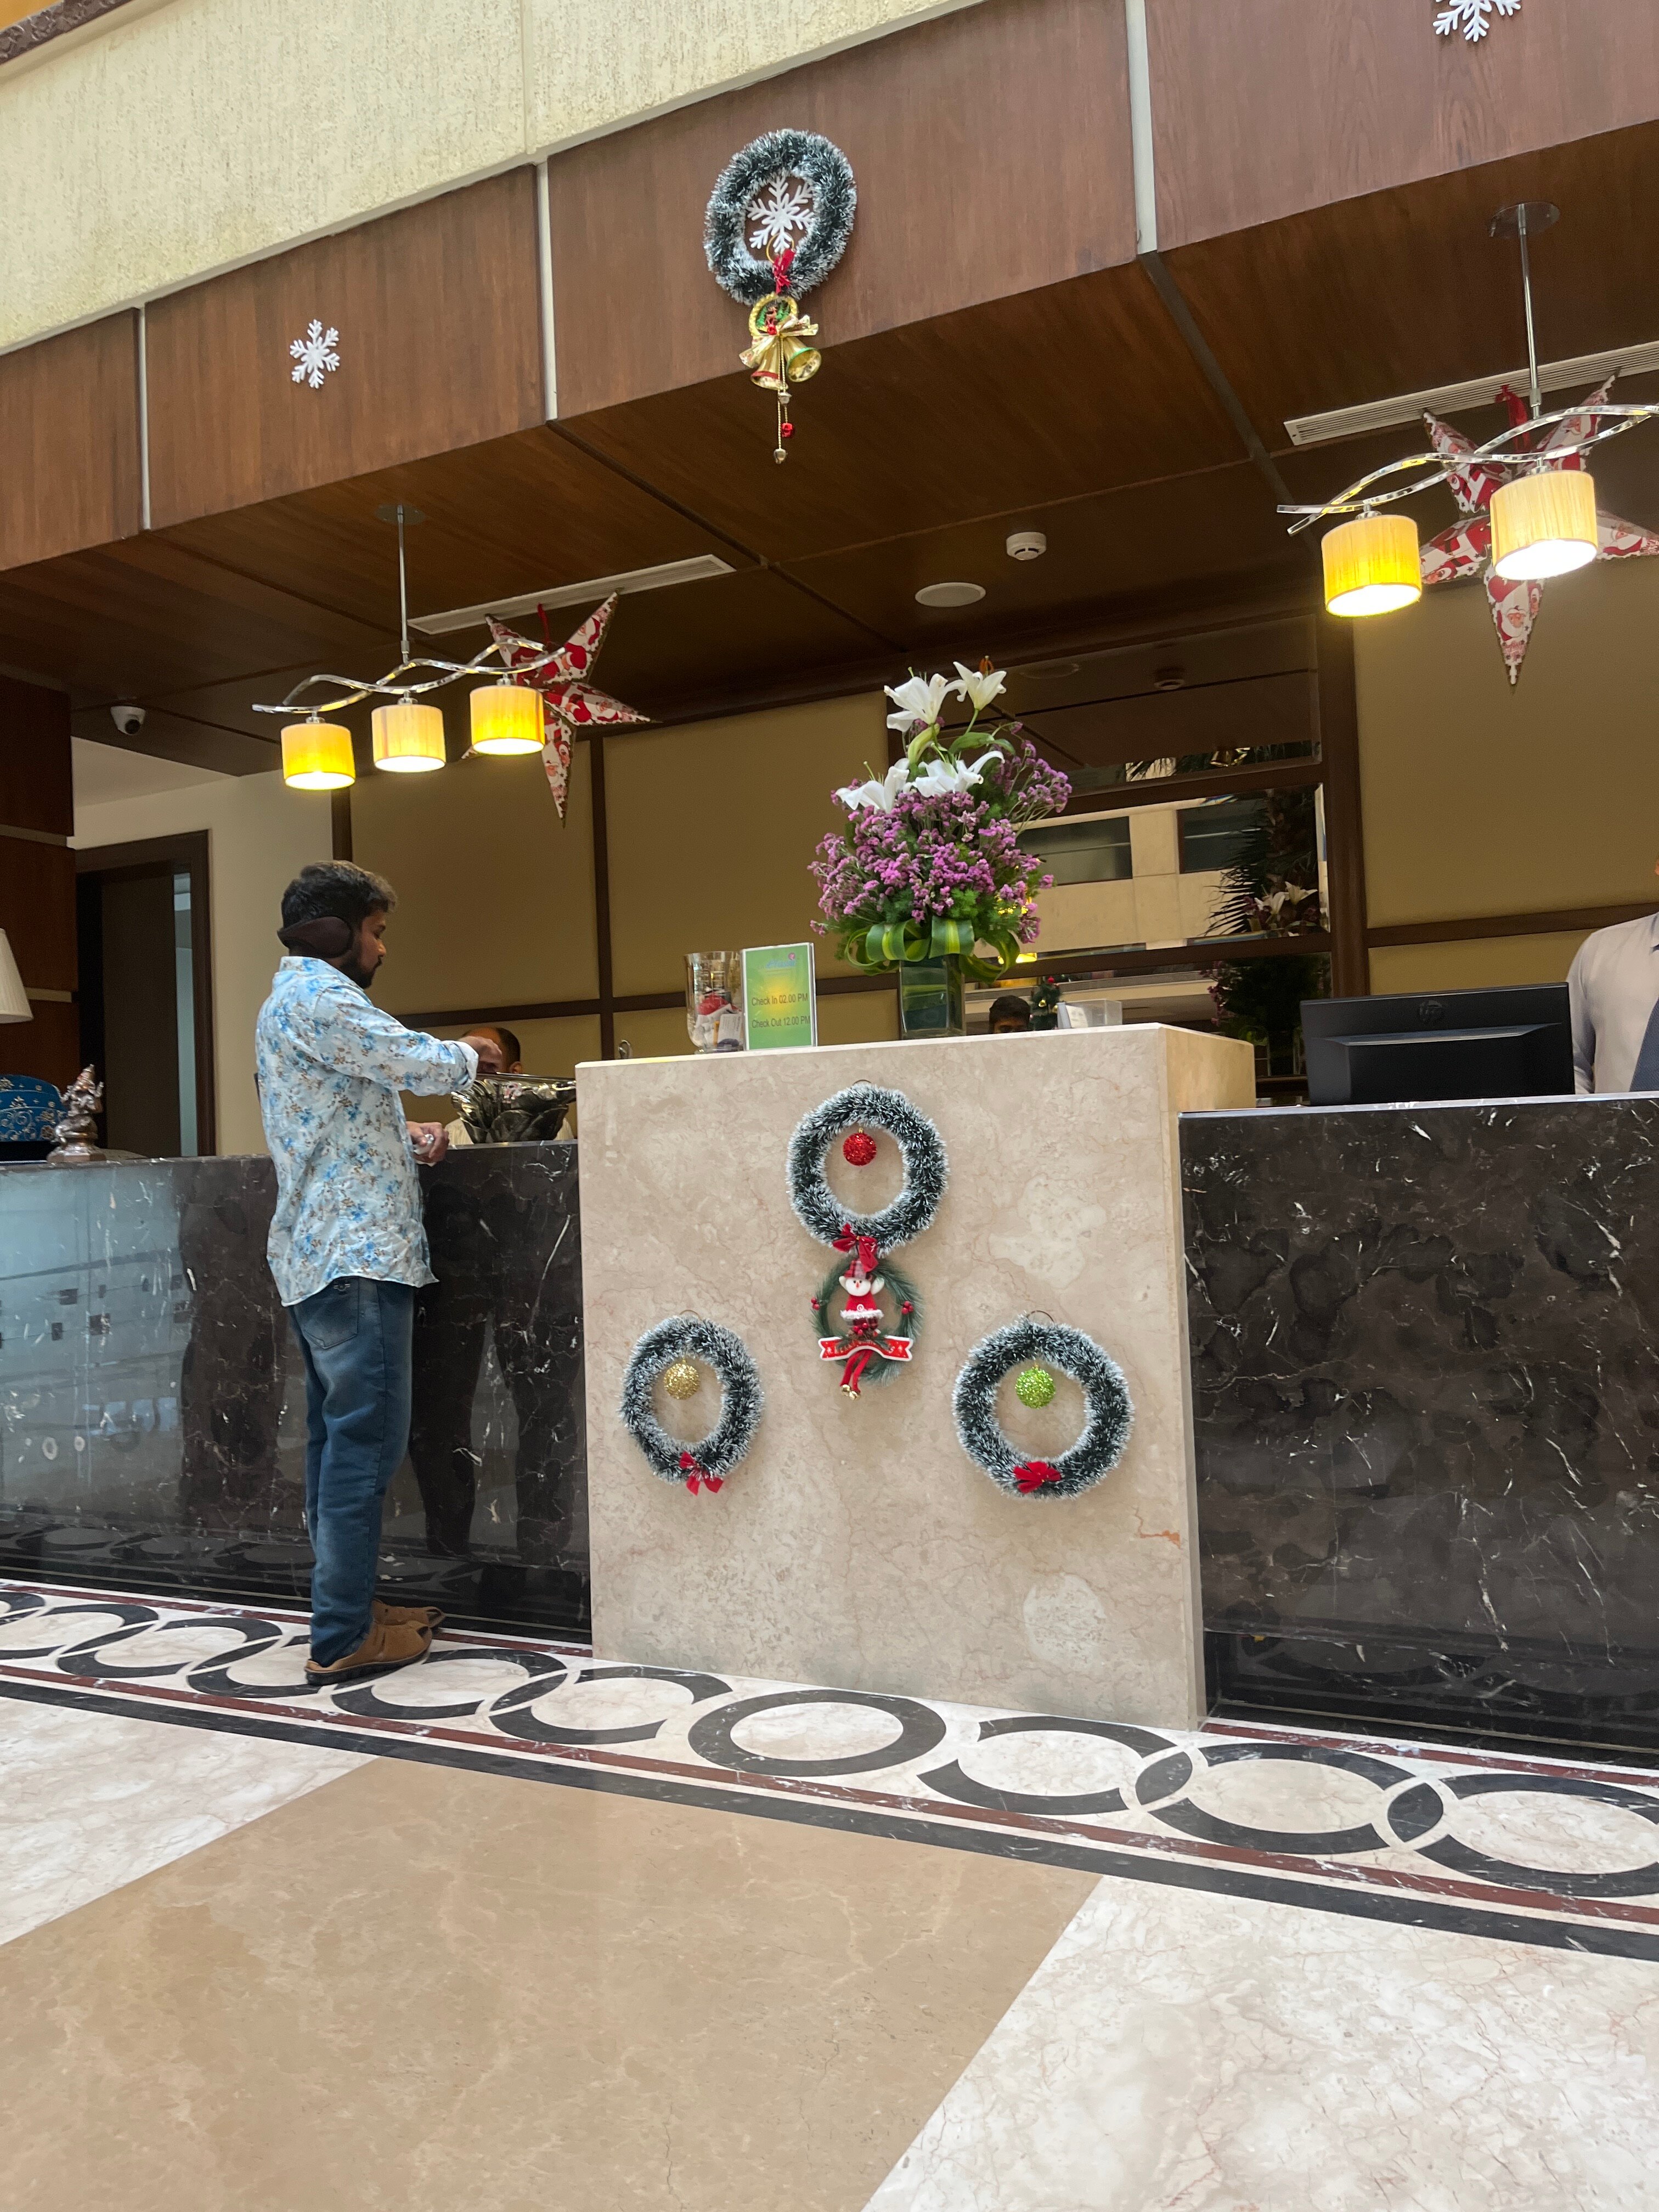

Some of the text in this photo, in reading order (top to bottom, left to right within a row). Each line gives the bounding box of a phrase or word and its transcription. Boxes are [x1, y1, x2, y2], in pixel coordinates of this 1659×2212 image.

[752, 993, 808, 1006] Check In 02.00 PM
[752, 1015, 810, 1028] Check Out 12.00 PM
